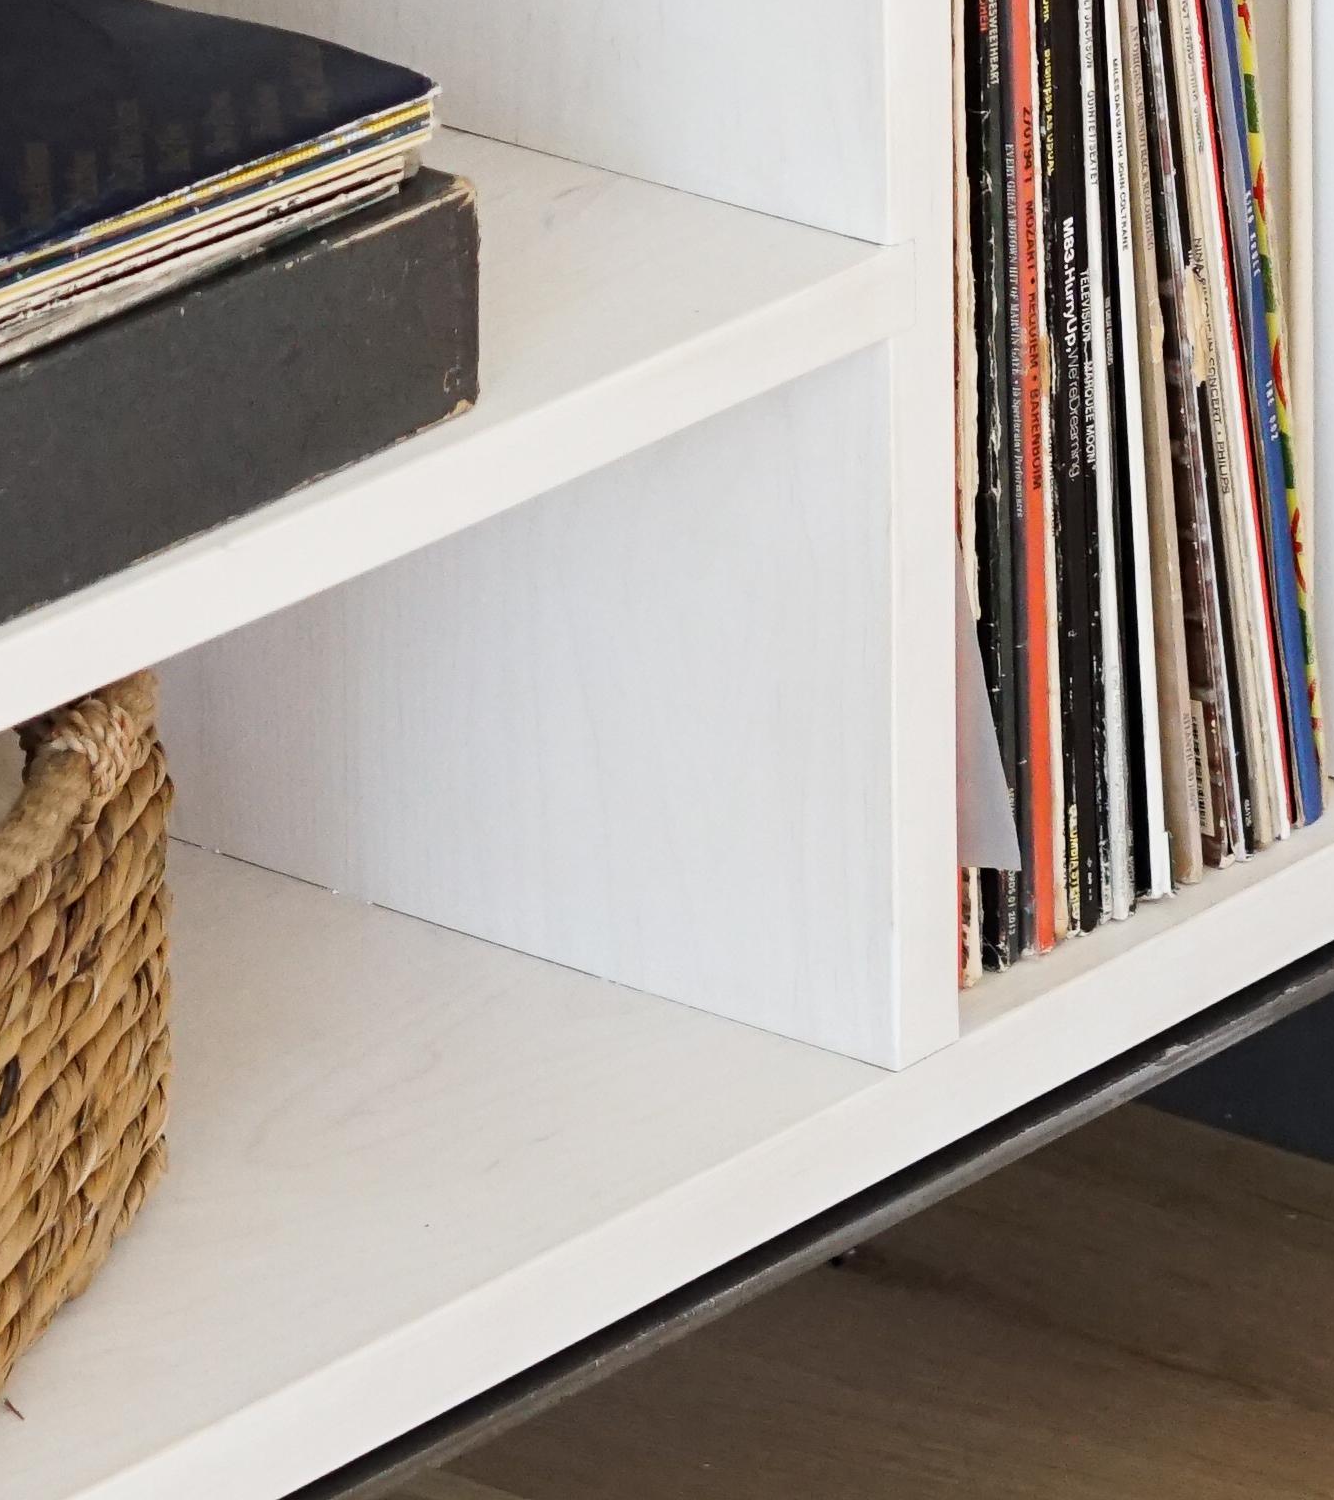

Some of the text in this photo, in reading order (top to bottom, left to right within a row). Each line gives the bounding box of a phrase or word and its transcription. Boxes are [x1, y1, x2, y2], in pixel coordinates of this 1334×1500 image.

[1082, 12, 1096, 70] JACKSON
[1042, 48, 1054, 113] BUSINESS
[1129, 42, 1145, 101] ORIGINAL
[1044, 113, 1055, 133] AS
[1086, 89, 1100, 188] QUINTET/SEXTET
[1134, 100, 1151, 182] SOUNDTRACK
[1003, 143, 1016, 180] EVERY
[1045, 132, 1056, 177] USUAL
[1111, 57, 1130, 253] MILES DAVIS WITH JOHN COLTRANE
[1004, 180, 1017, 217] GREAT
[1140, 182, 1156, 253] RECORDING
[1243, 190, 1256, 224] KING
[1005, 217, 1018, 264] MOTOWN
[1024, 199, 1038, 270] MOZART
[1007, 265, 1019, 286] HIT
[1007, 286, 1019, 302] OF
[1008, 302, 1021, 346] MARVIN
[1026, 291, 1040, 370] REQUIEM
[1079, 268, 1092, 343] TELEVISION
[1009, 346, 1021, 376] GAYE
[1083, 360, 1097, 423] MARQUEE
[1011, 398, 1023, 453] Spectacular
[1028, 388, 1043, 492] BARENBOIM
[1084, 424, 1097, 464] MOON
[1013, 454, 1025, 519] Performances
[1215, 440, 1232, 495] PHILIPS
[1007, 911, 1016, 936] 2013
